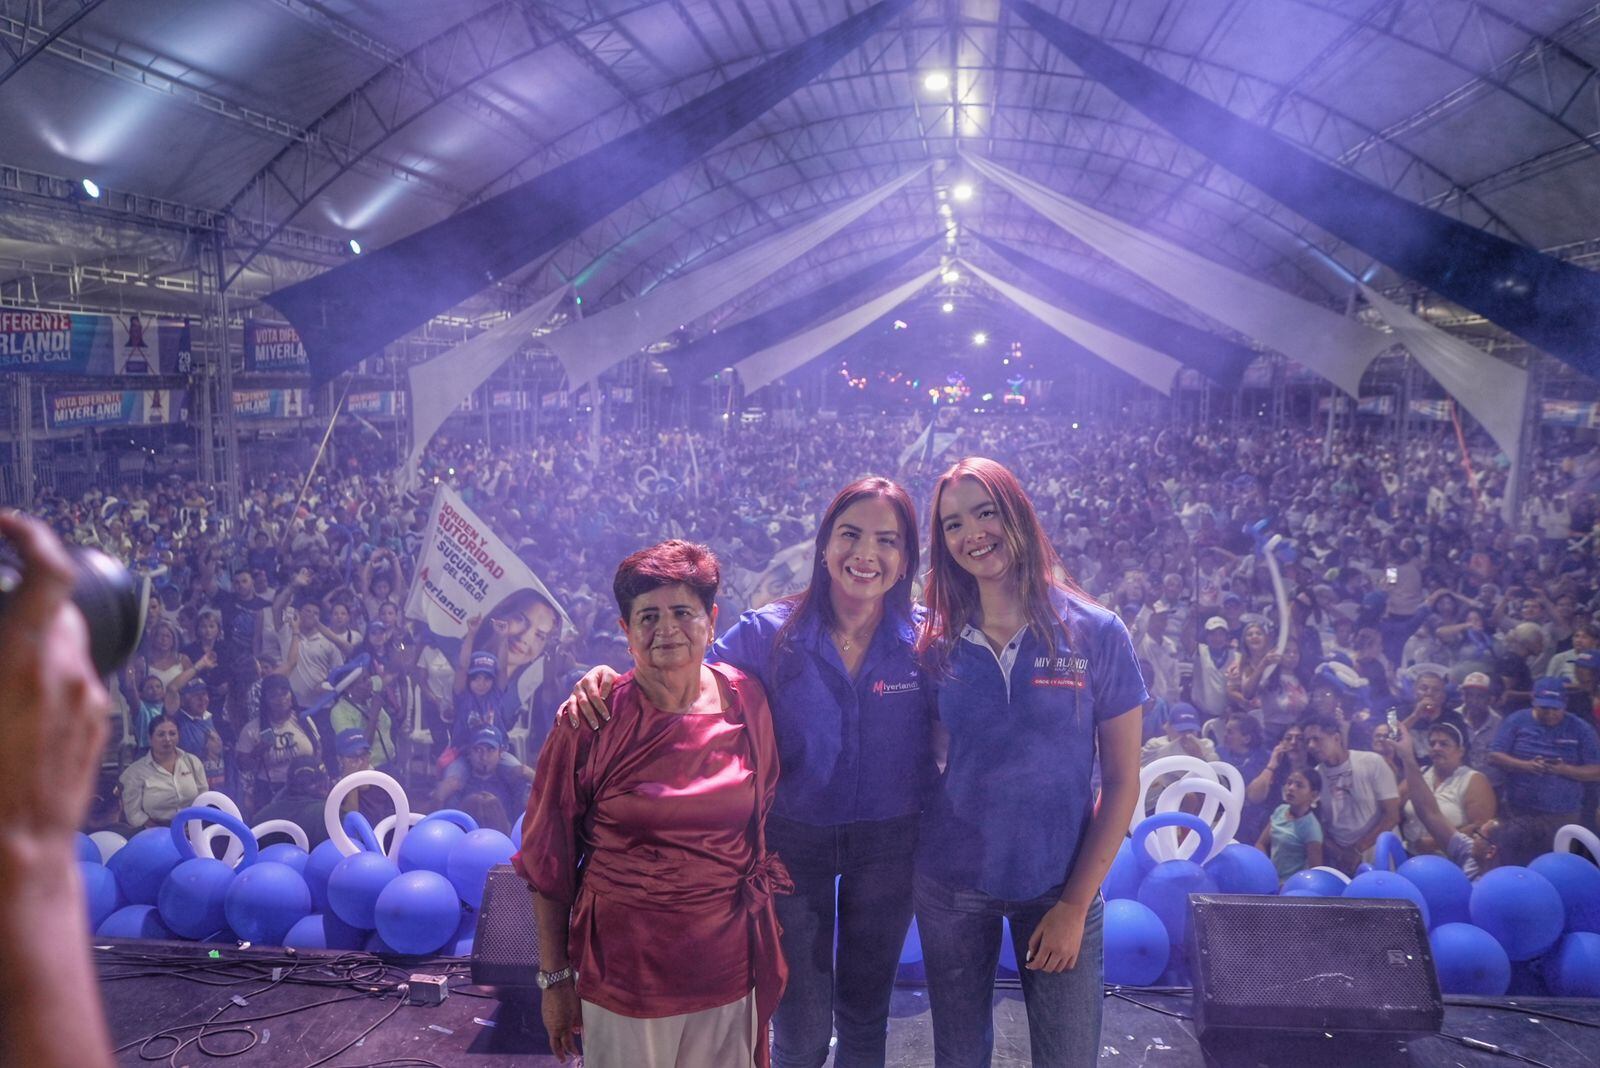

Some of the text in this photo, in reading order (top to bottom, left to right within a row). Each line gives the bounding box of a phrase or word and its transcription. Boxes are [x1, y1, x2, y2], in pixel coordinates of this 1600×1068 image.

[255, 328, 278, 343] VOTA
[22, 353, 40, 363] DE
[43, 351, 71, 362] CALI
[178, 351, 191, 363] 29
[55, 391, 122, 409] VOTA DIFERENTE
[54, 401, 122, 422] MIYERLANDI
[480, 537, 488, 548] Y
[437, 540, 489, 596] SUCURSAL
[443, 562, 459, 579] DEL
